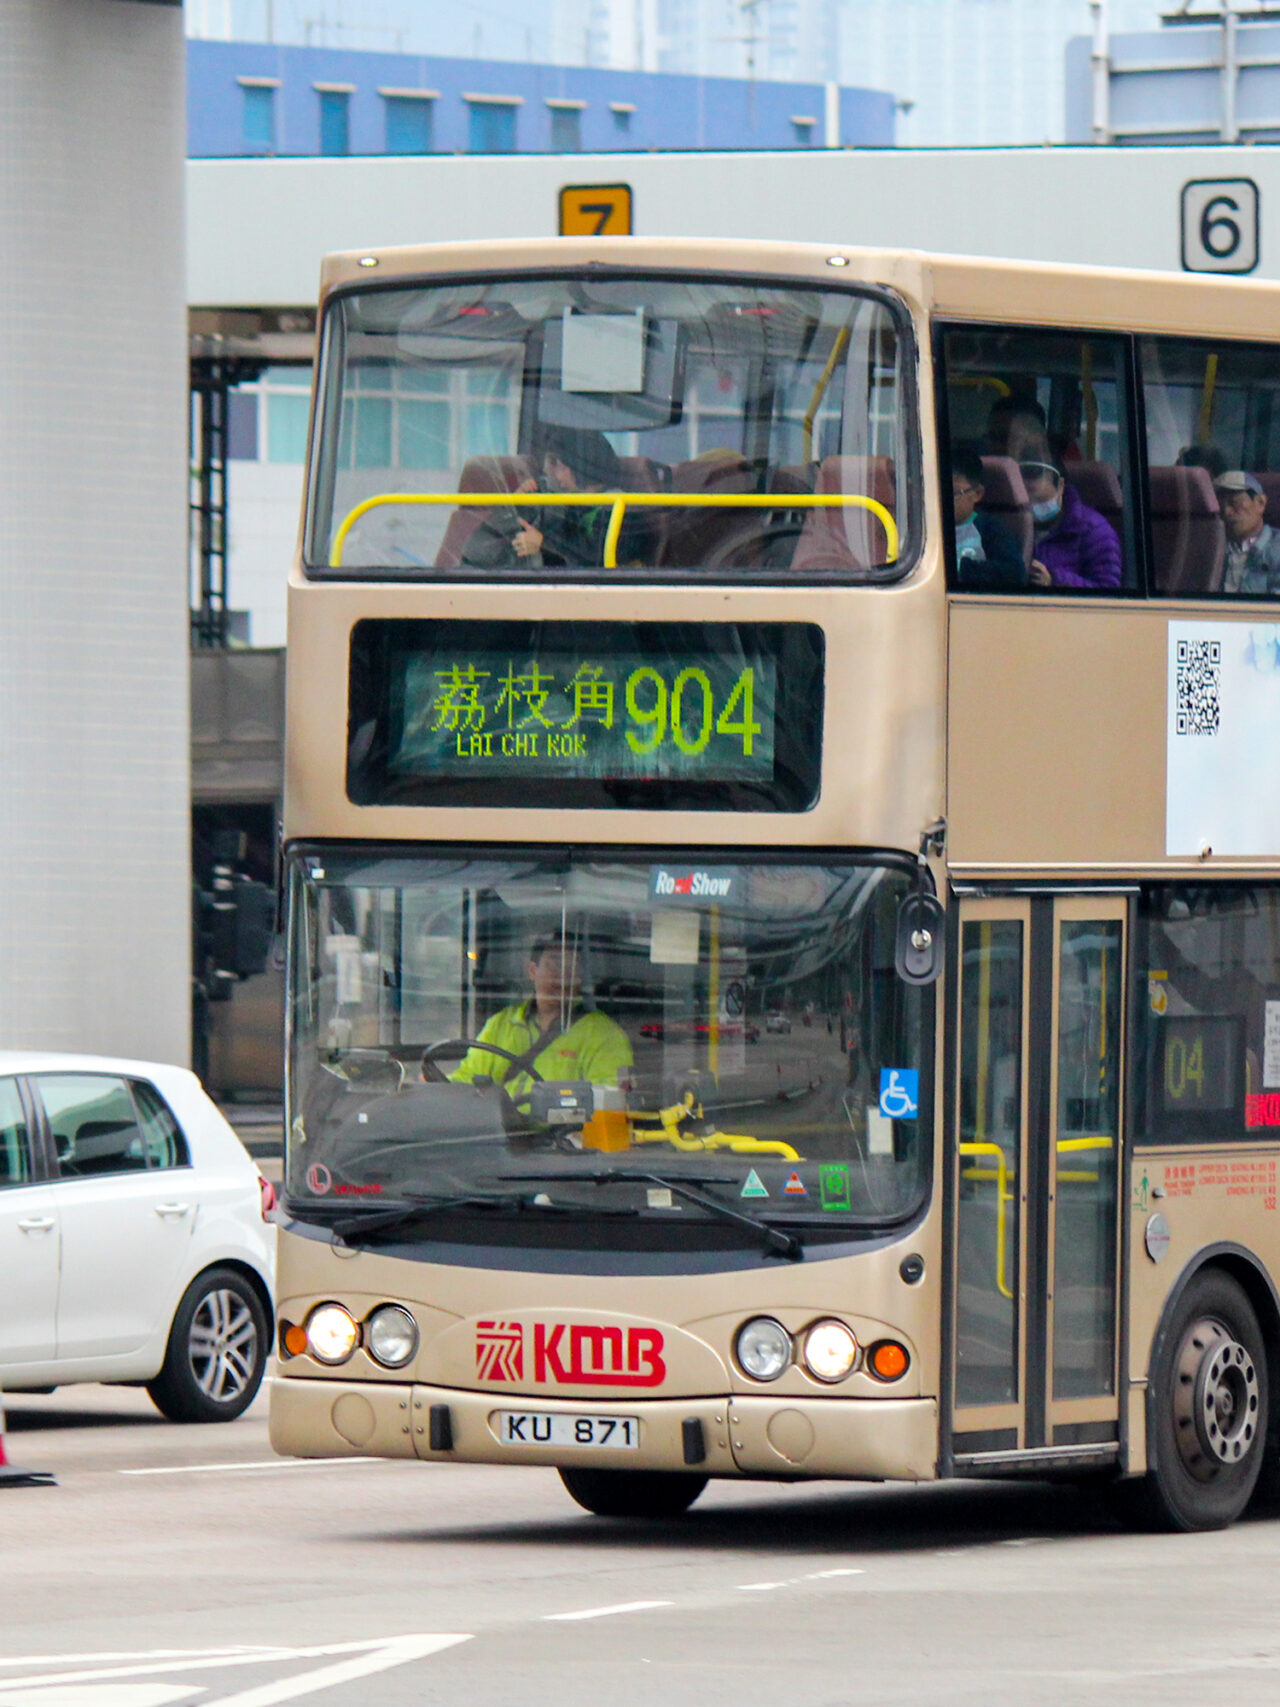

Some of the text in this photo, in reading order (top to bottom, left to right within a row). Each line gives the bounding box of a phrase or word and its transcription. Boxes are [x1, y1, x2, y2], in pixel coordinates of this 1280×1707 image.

[580, 204, 614, 236] 7
[1201, 196, 1240, 258] 6
[432, 660, 614, 732] 荔枝角
[625, 666, 761, 756] 904
[456, 733, 586, 757] LAI CHI KOK
[534, 1323, 666, 1388] KMB
[509, 1416, 631, 1445] KU 871
